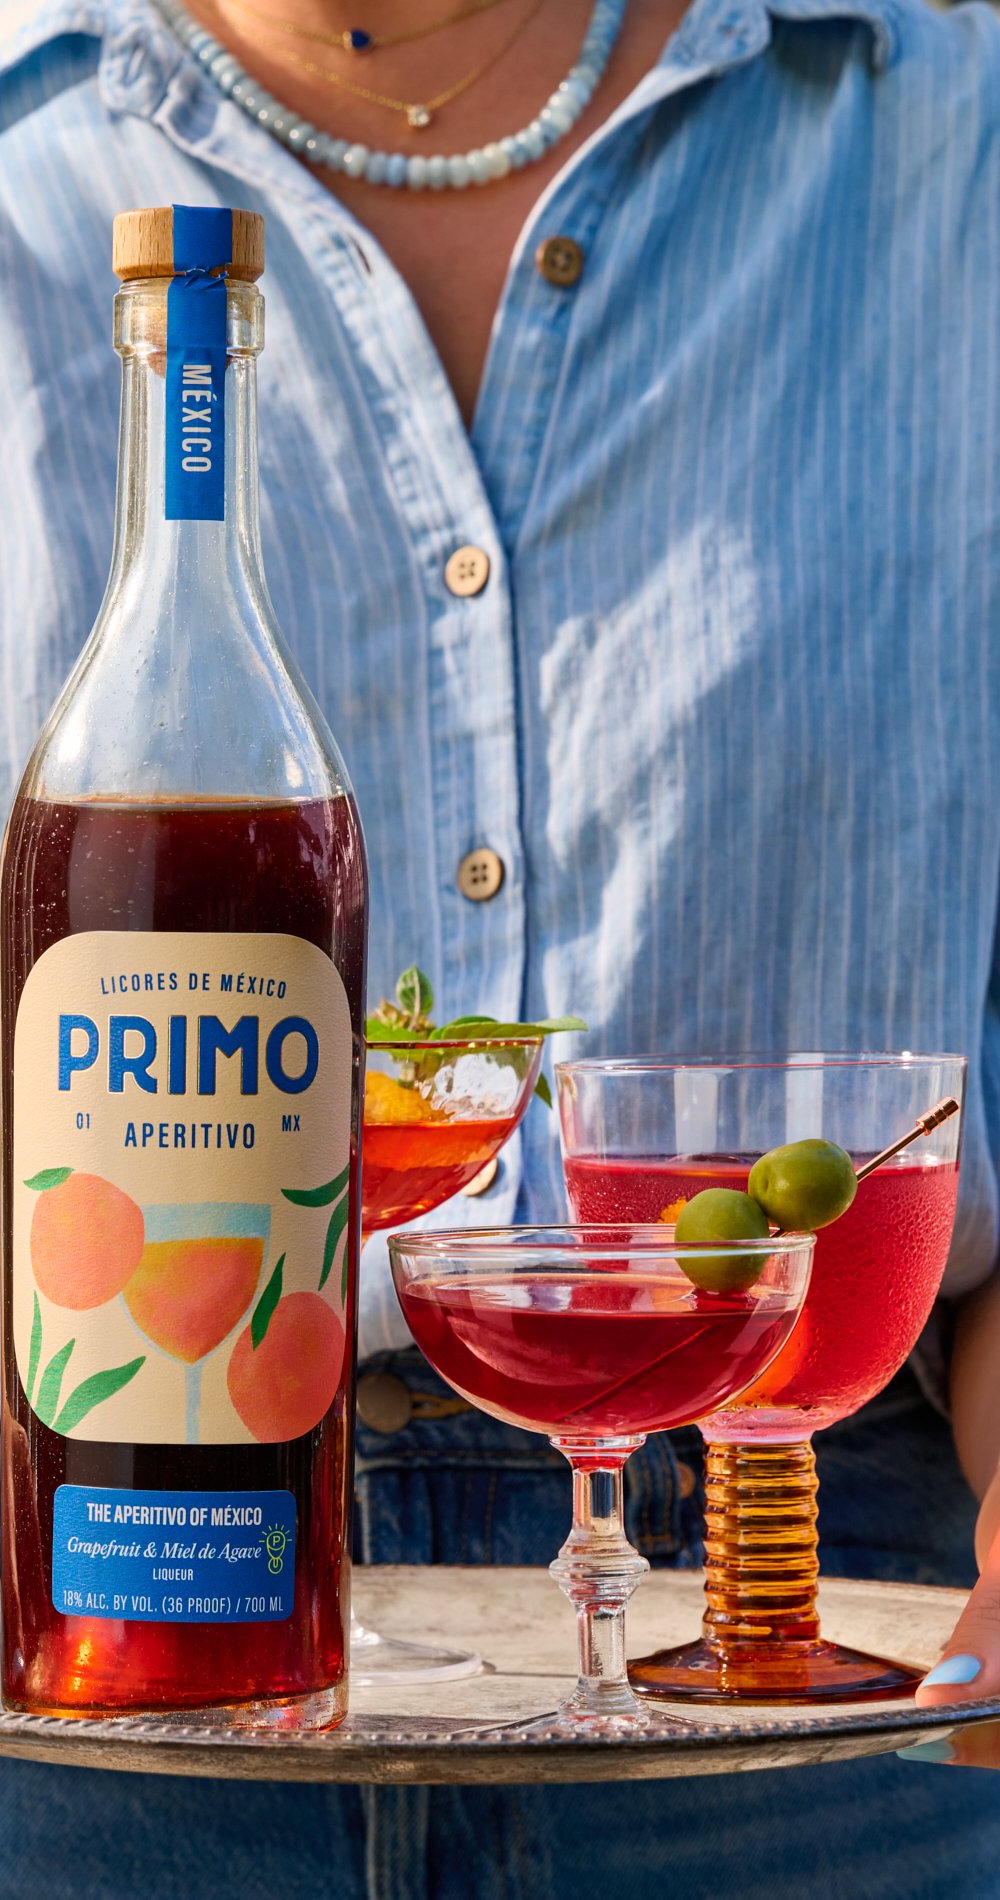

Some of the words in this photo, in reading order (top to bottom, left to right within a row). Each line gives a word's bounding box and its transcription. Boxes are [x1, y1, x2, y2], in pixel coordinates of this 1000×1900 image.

[181, 364, 217, 473] MÉXICO
[100, 973, 178, 995] LICORES
[189, 973, 210, 991] DE
[220, 972, 287, 999] MÉXICO
[57, 1014, 320, 1095] PRIMO
[76, 1113, 90, 1130] 01
[281, 1114, 301, 1132] MX
[124, 1122, 256, 1149] APERITIVO
[87, 1503, 111, 1523] THE
[113, 1505, 187, 1526] APERITIVO
[189, 1507, 208, 1526] OF
[210, 1504, 262, 1526] MÉXICO
[67, 1536, 141, 1559] Grapefruit
[143, 1541, 157, 1558] &
[160, 1542, 195, 1559] Miel
[198, 1542, 215, 1559] de
[218, 1543, 262, 1563] Agave
[152, 1568, 194, 1581] LIQUEUR
[63, 1590, 82, 1607] 18%
[86, 1593, 109, 1610] ALC.
[113, 1594, 128, 1611] BY
[131, 1596, 158, 1612] VOL.
[162, 1596, 183, 1615] (36
[187, 1597, 231, 1615] PROOF)
[235, 1597, 241, 1614] /
[245, 1597, 266, 1613] 700
[269, 1596, 284, 1612] ML
